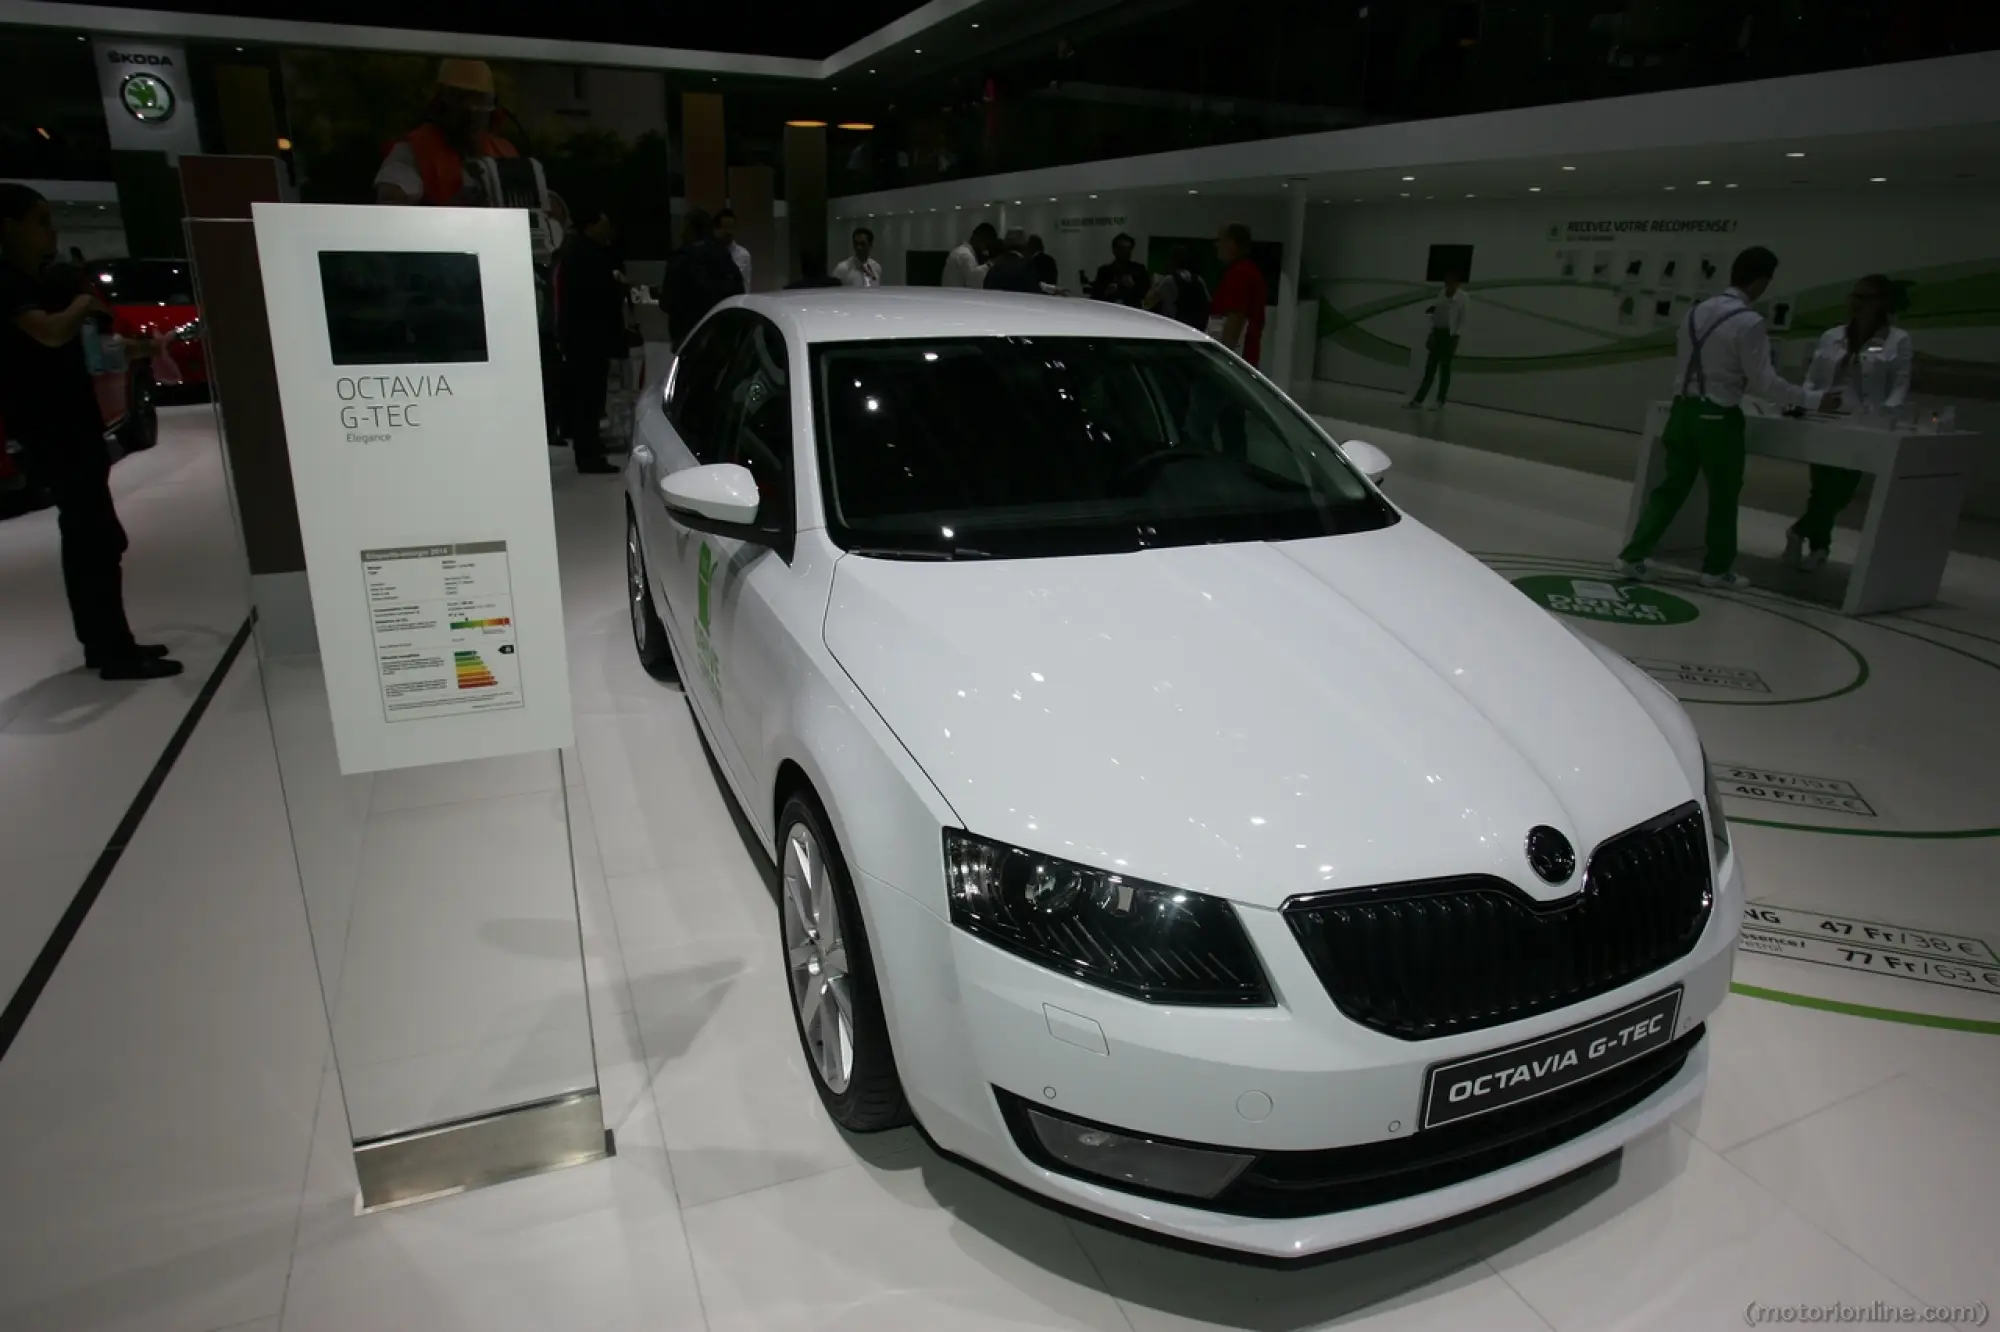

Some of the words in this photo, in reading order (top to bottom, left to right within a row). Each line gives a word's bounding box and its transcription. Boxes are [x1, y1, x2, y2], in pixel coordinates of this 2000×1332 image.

[1614, 221, 1649, 232] VOTRE
[336, 375, 453, 400] OCTAVIA
[341, 404, 421, 428] G-TEC
[347, 433, 391, 444] Elegance
[1743, 909, 1781, 923] NG
[1820, 921, 1853, 935] 47
[1837, 948, 1873, 965] 77
[1449, 1049, 1578, 1102] OCTAVIA
[1588, 1014, 1664, 1059] G-TEC
